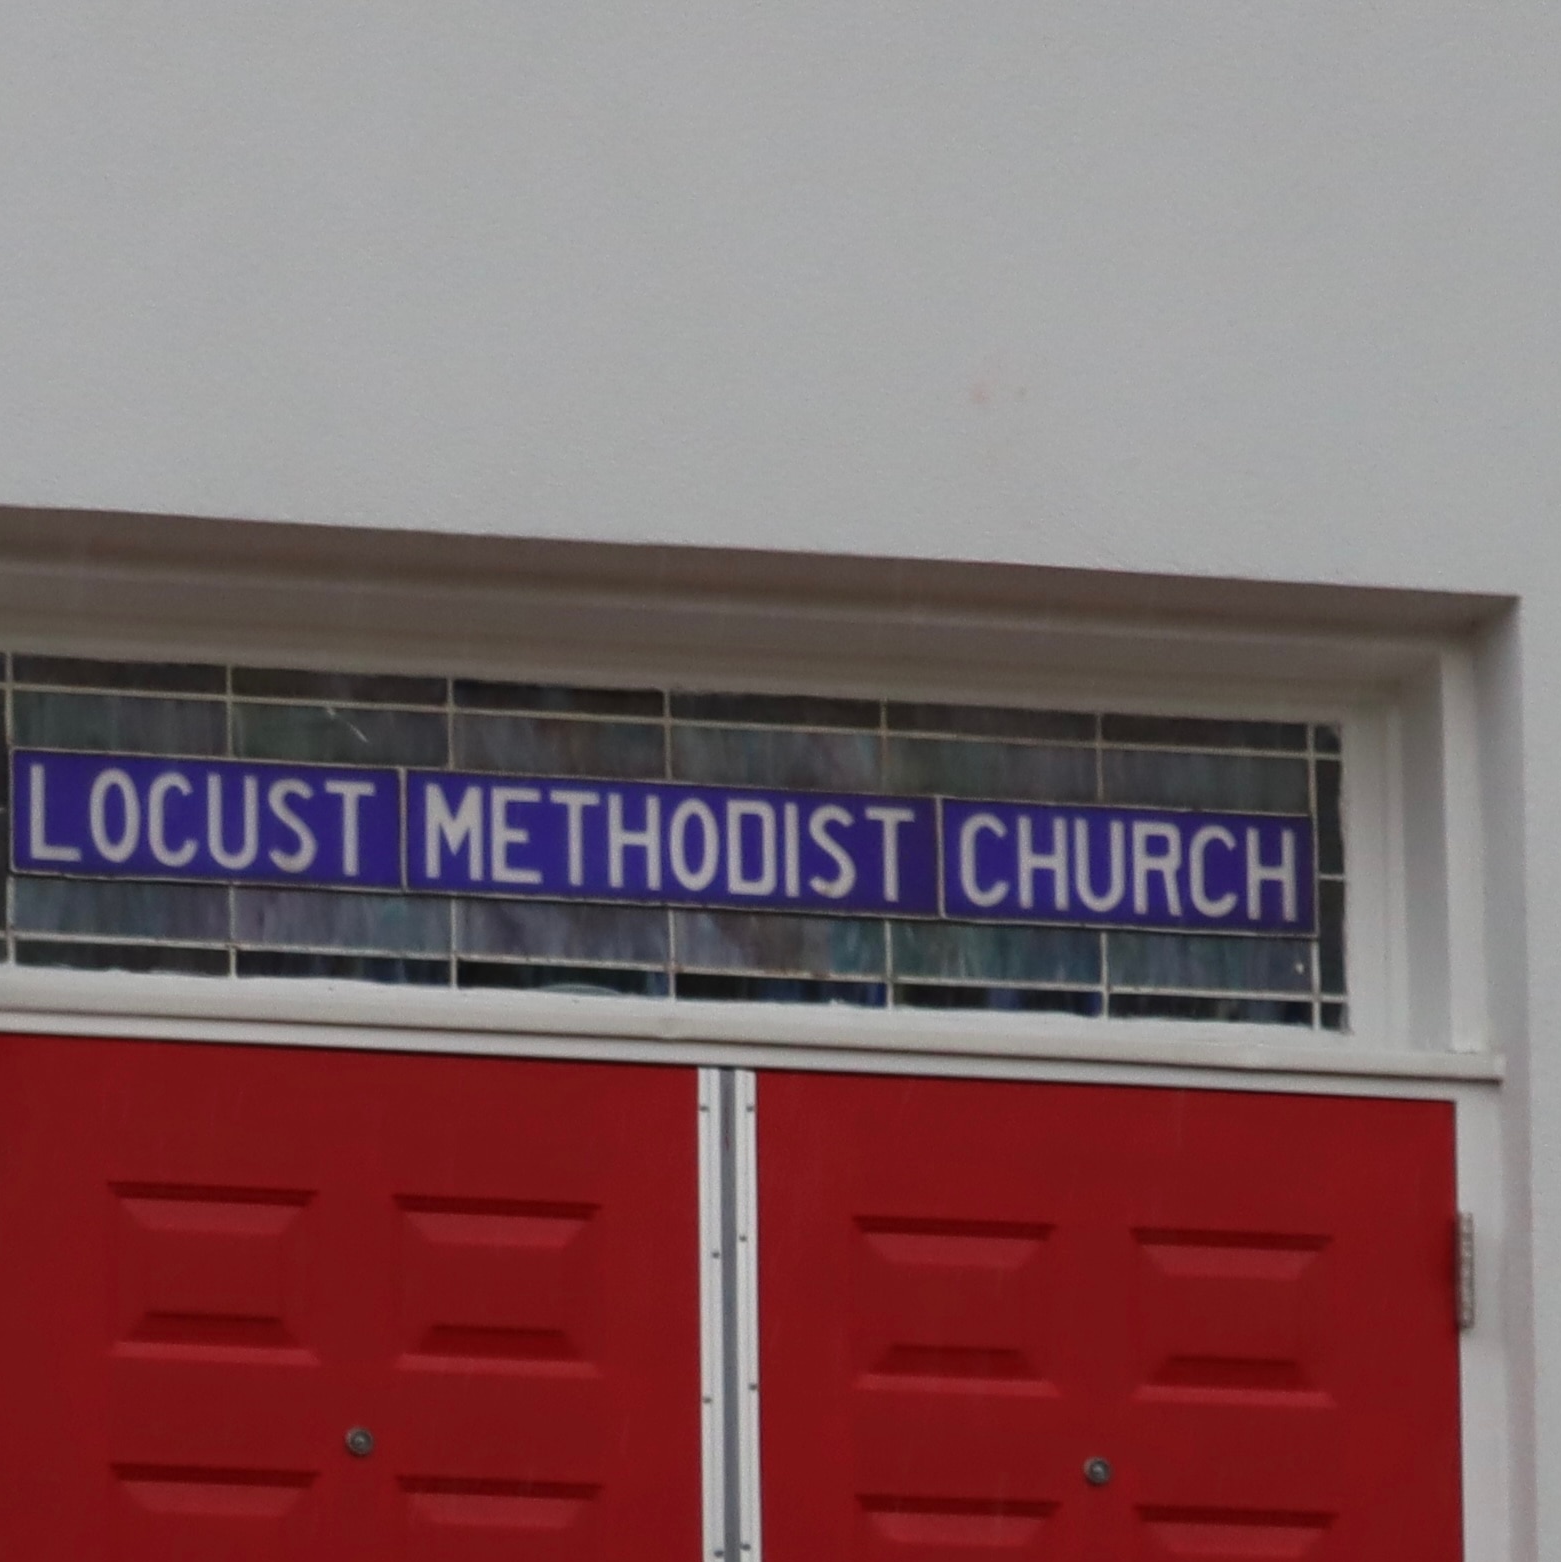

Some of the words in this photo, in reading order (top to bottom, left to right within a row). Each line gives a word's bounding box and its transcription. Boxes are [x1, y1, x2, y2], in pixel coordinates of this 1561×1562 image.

[27, 762, 377, 878] LOCUST
[423, 781, 916, 904] METHODIST
[957, 810, 1297, 923] CHURCH
